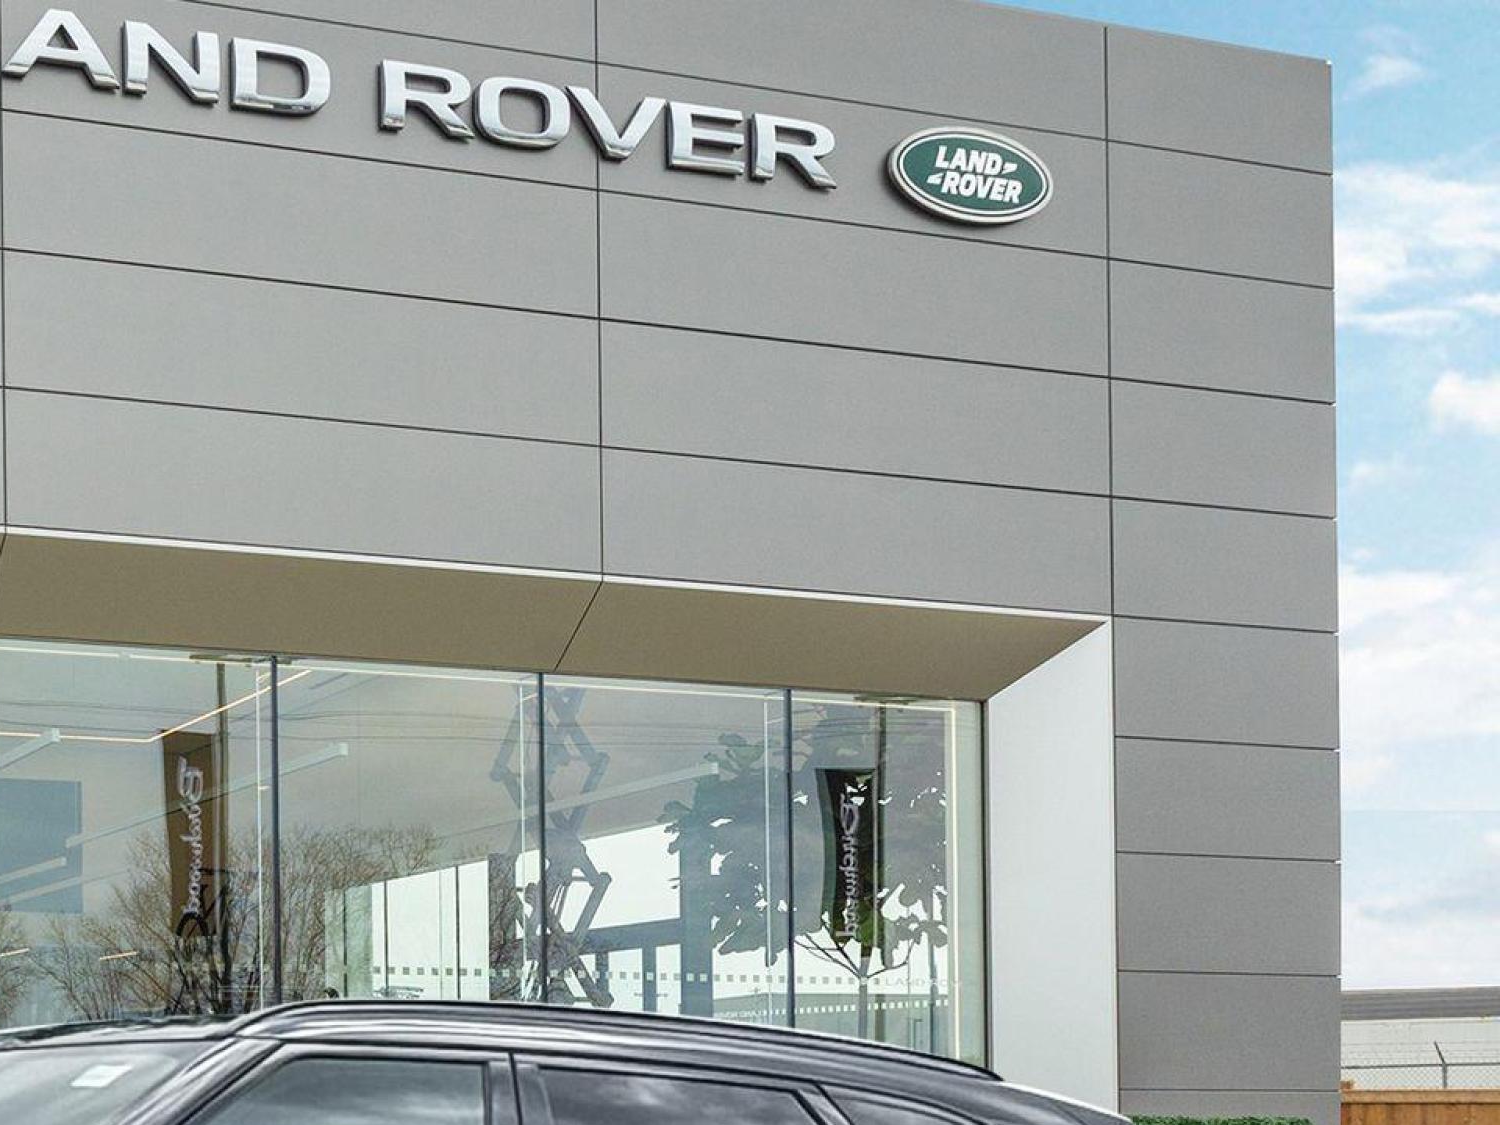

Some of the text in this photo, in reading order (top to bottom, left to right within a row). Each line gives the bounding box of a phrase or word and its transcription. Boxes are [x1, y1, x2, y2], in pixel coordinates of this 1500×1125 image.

[377, 58, 837, 190] ROVER
[934, 145, 1003, 175] LAND
[941, 171, 1023, 204] ROVER
